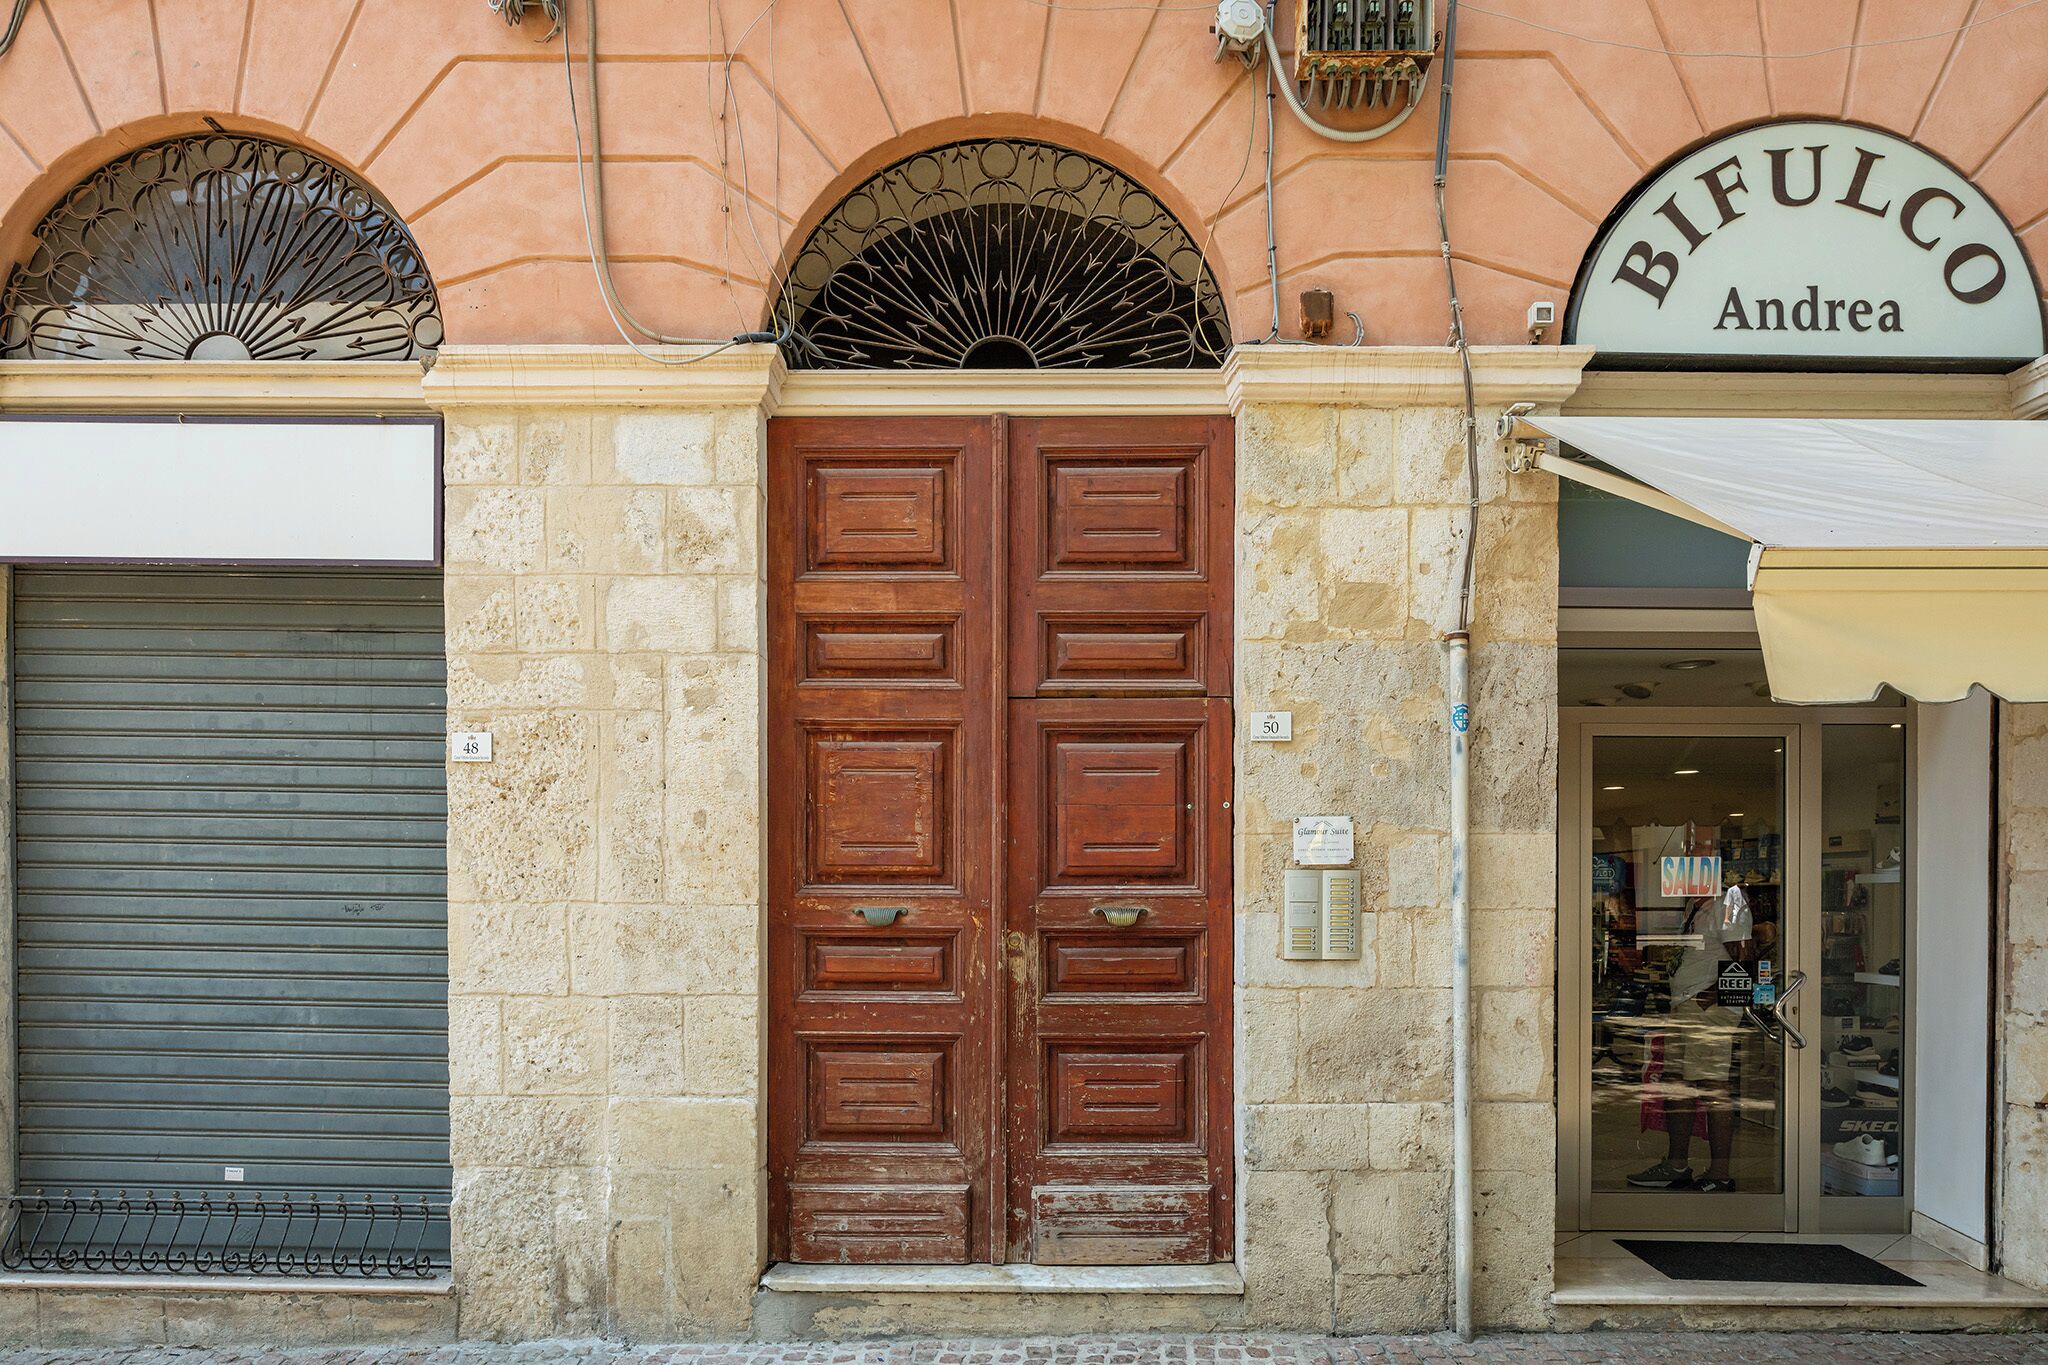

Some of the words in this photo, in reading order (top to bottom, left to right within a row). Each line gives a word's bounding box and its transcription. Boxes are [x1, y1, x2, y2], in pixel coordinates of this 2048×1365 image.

[1611, 145, 2006, 309] BIFULCO
[1713, 285, 1905, 332] Andrea
[1263, 721, 1279, 734] 50
[463, 742, 479, 754] 48
[1298, 827, 1328, 837] Glamour
[1663, 856, 1720, 896] SALDI
[1720, 979, 1751, 988] REEF
[1838, 1120, 1900, 1132] SKEC
